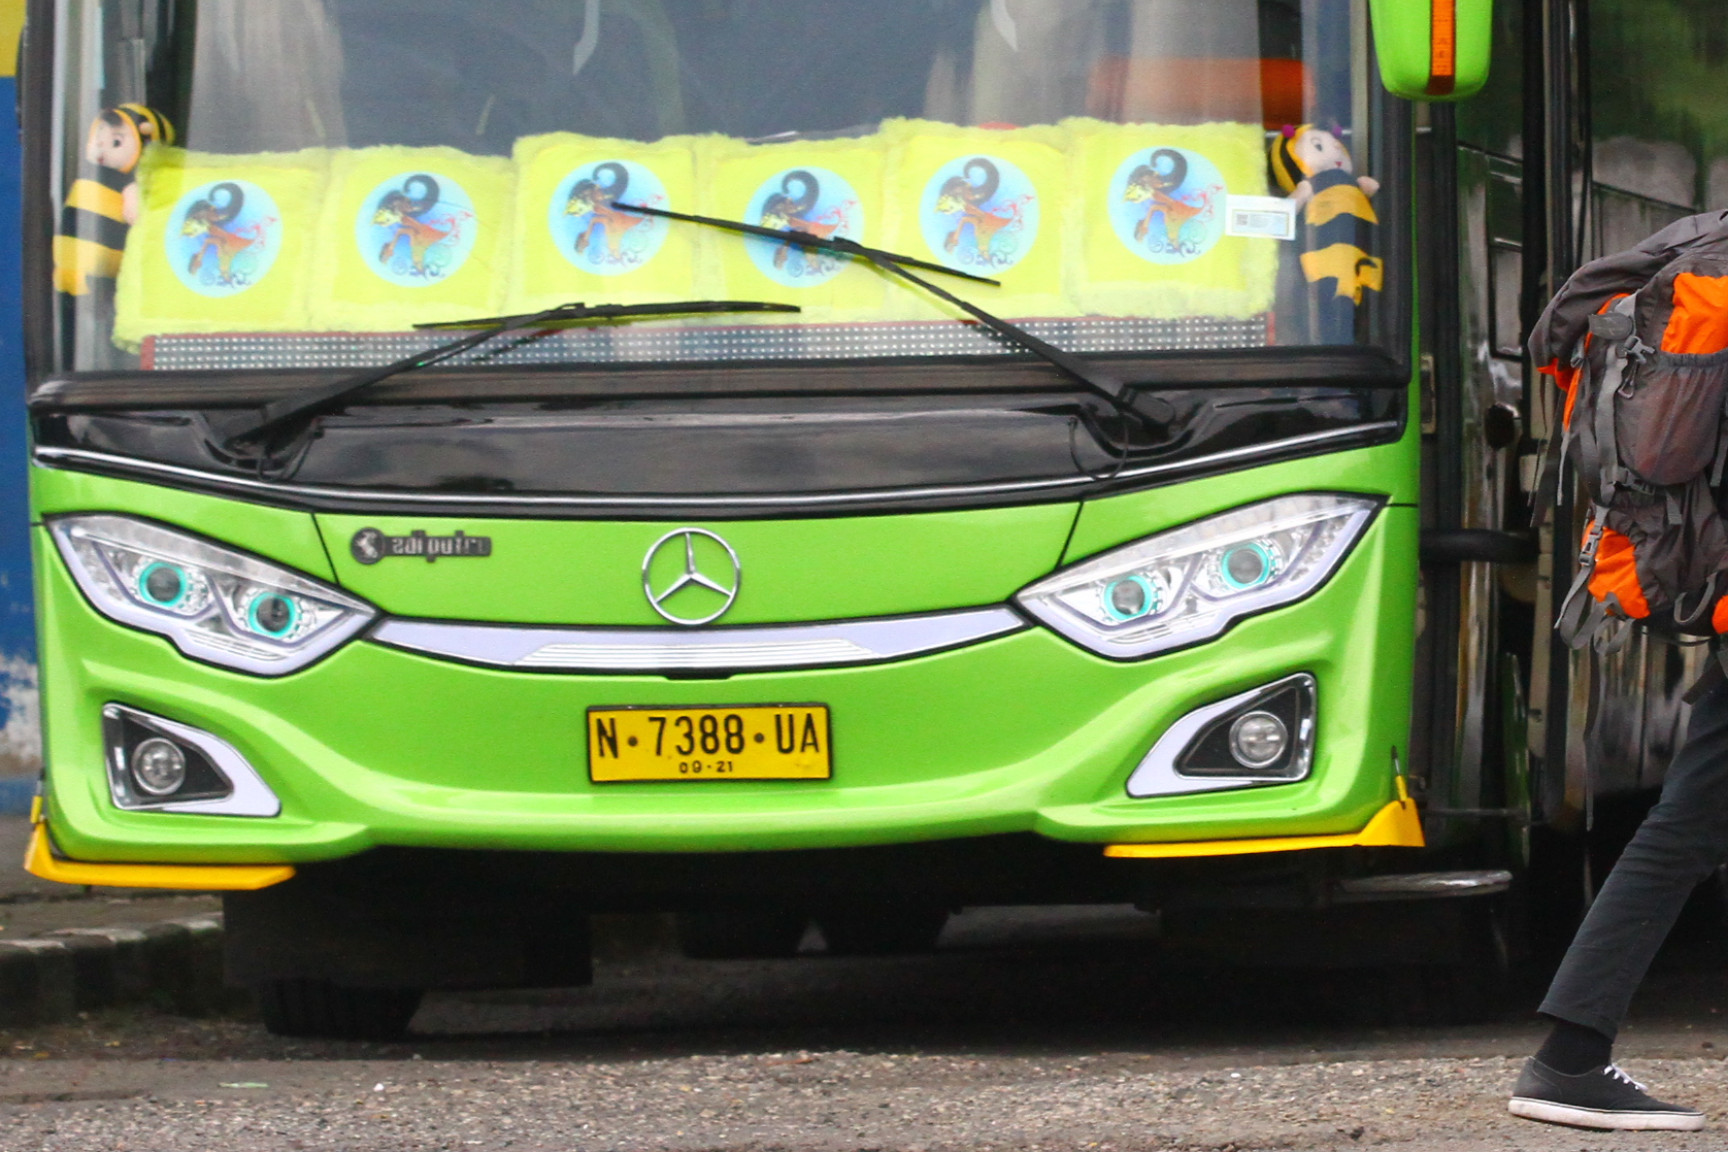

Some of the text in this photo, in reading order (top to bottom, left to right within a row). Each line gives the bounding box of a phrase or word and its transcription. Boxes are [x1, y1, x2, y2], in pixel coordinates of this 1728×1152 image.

[596, 713, 820, 759] N 7388 UA
